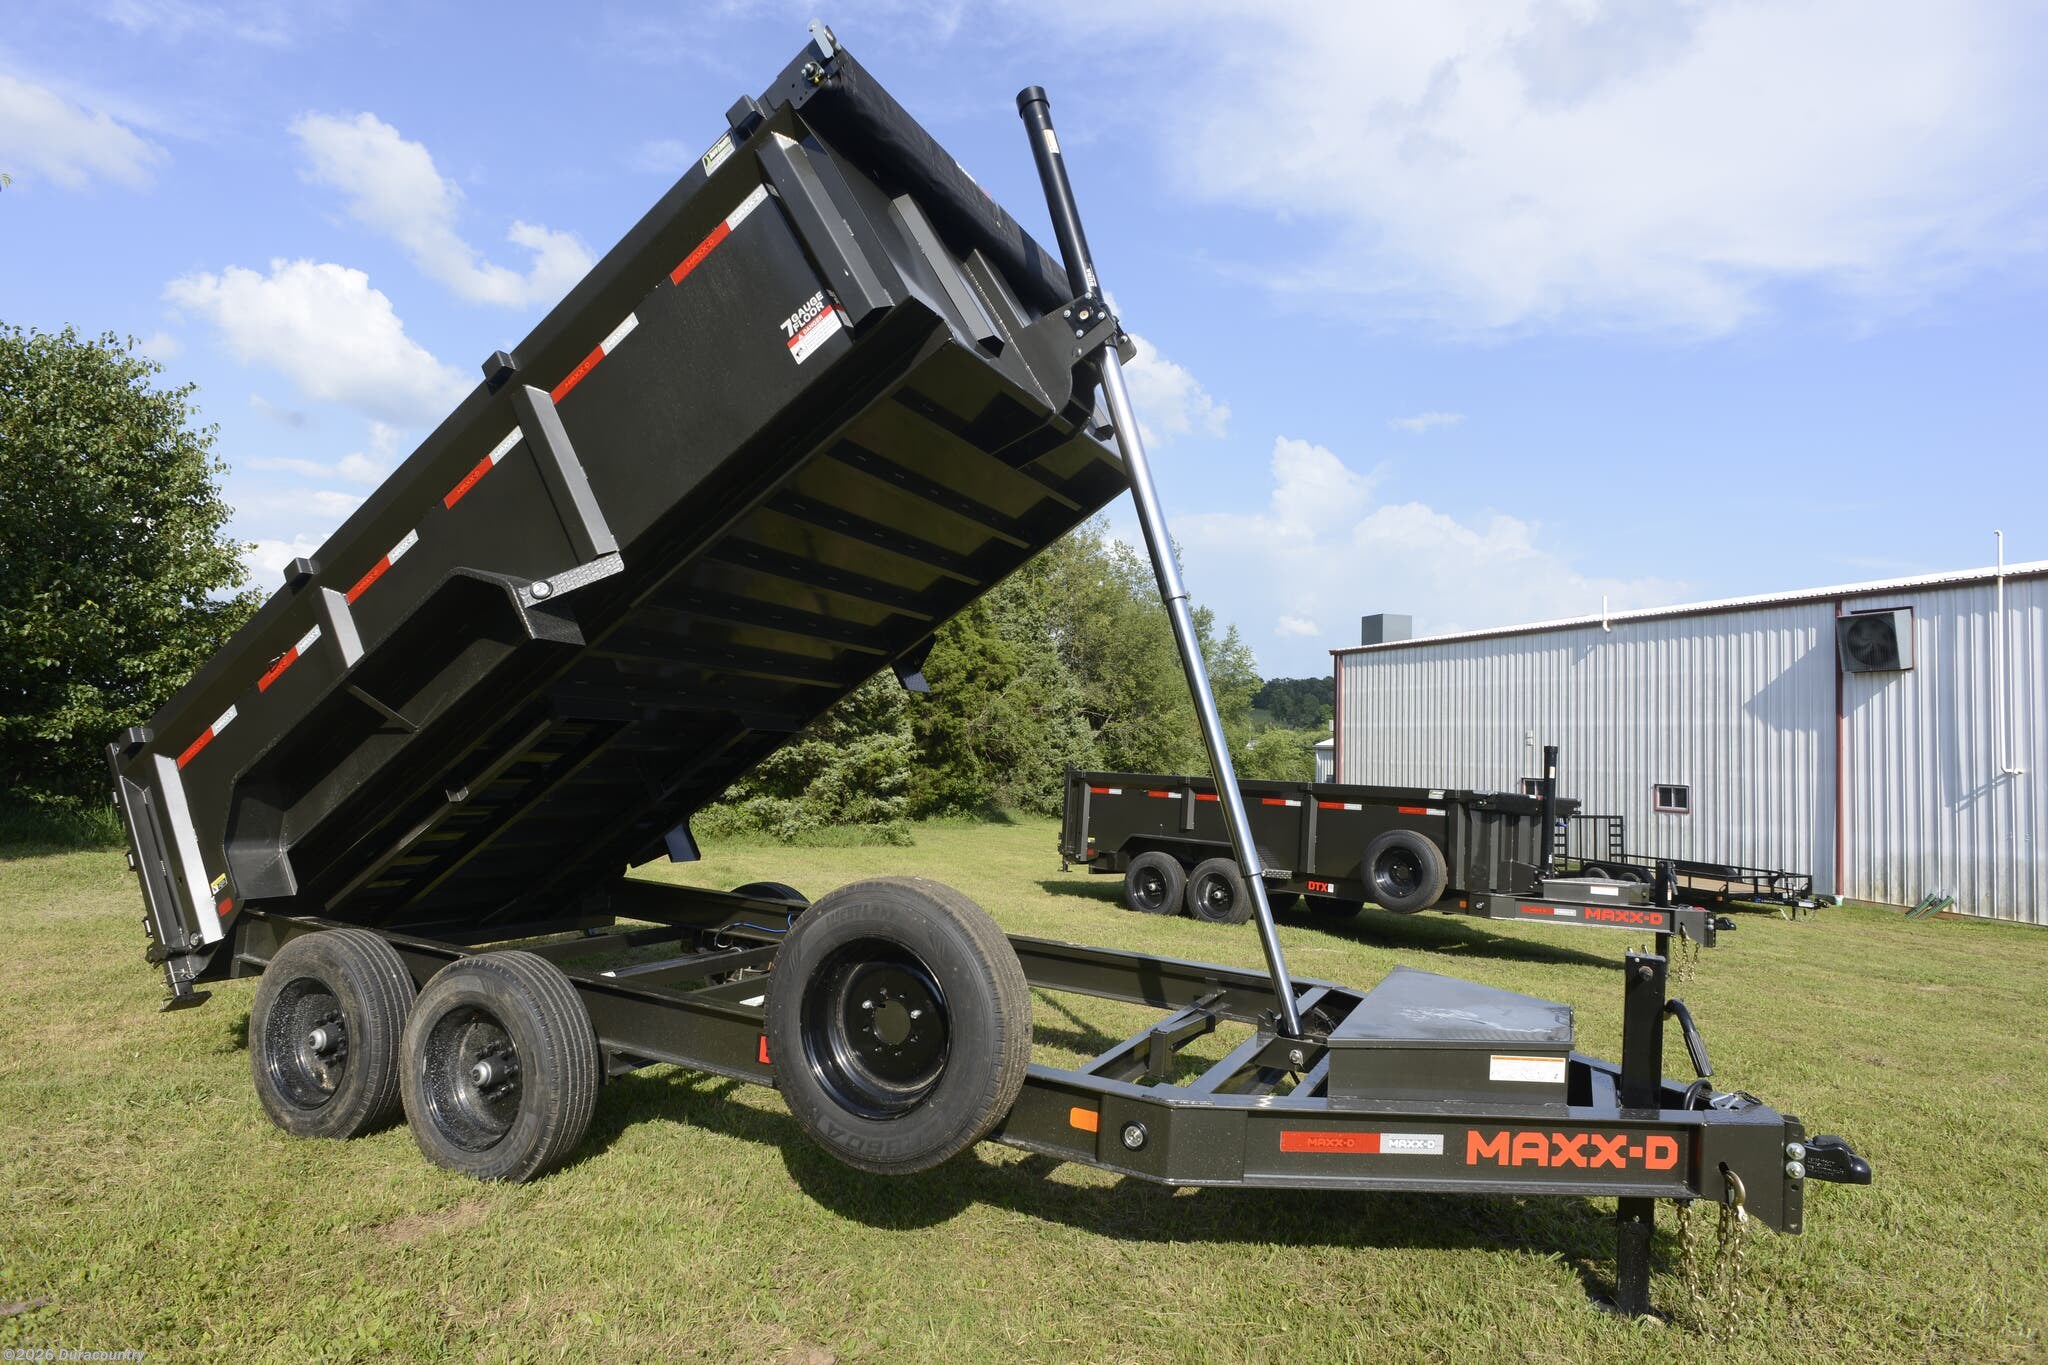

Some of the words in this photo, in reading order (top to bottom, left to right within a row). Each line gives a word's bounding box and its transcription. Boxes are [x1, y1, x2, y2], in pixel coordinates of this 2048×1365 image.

[780, 318, 795, 338] 7
[791, 290, 824, 323] GAUGE
[793, 301, 825, 333] FLOOR
[803, 314, 825, 335] DANGER
[1308, 880, 1328, 893] DTX
[1584, 906, 1663, 926] MAXX-D
[1307, 1137, 1356, 1148] MAXX-D
[1388, 1138, 1436, 1149] MAXX-D
[1466, 1130, 1679, 1170] MAXX-D
